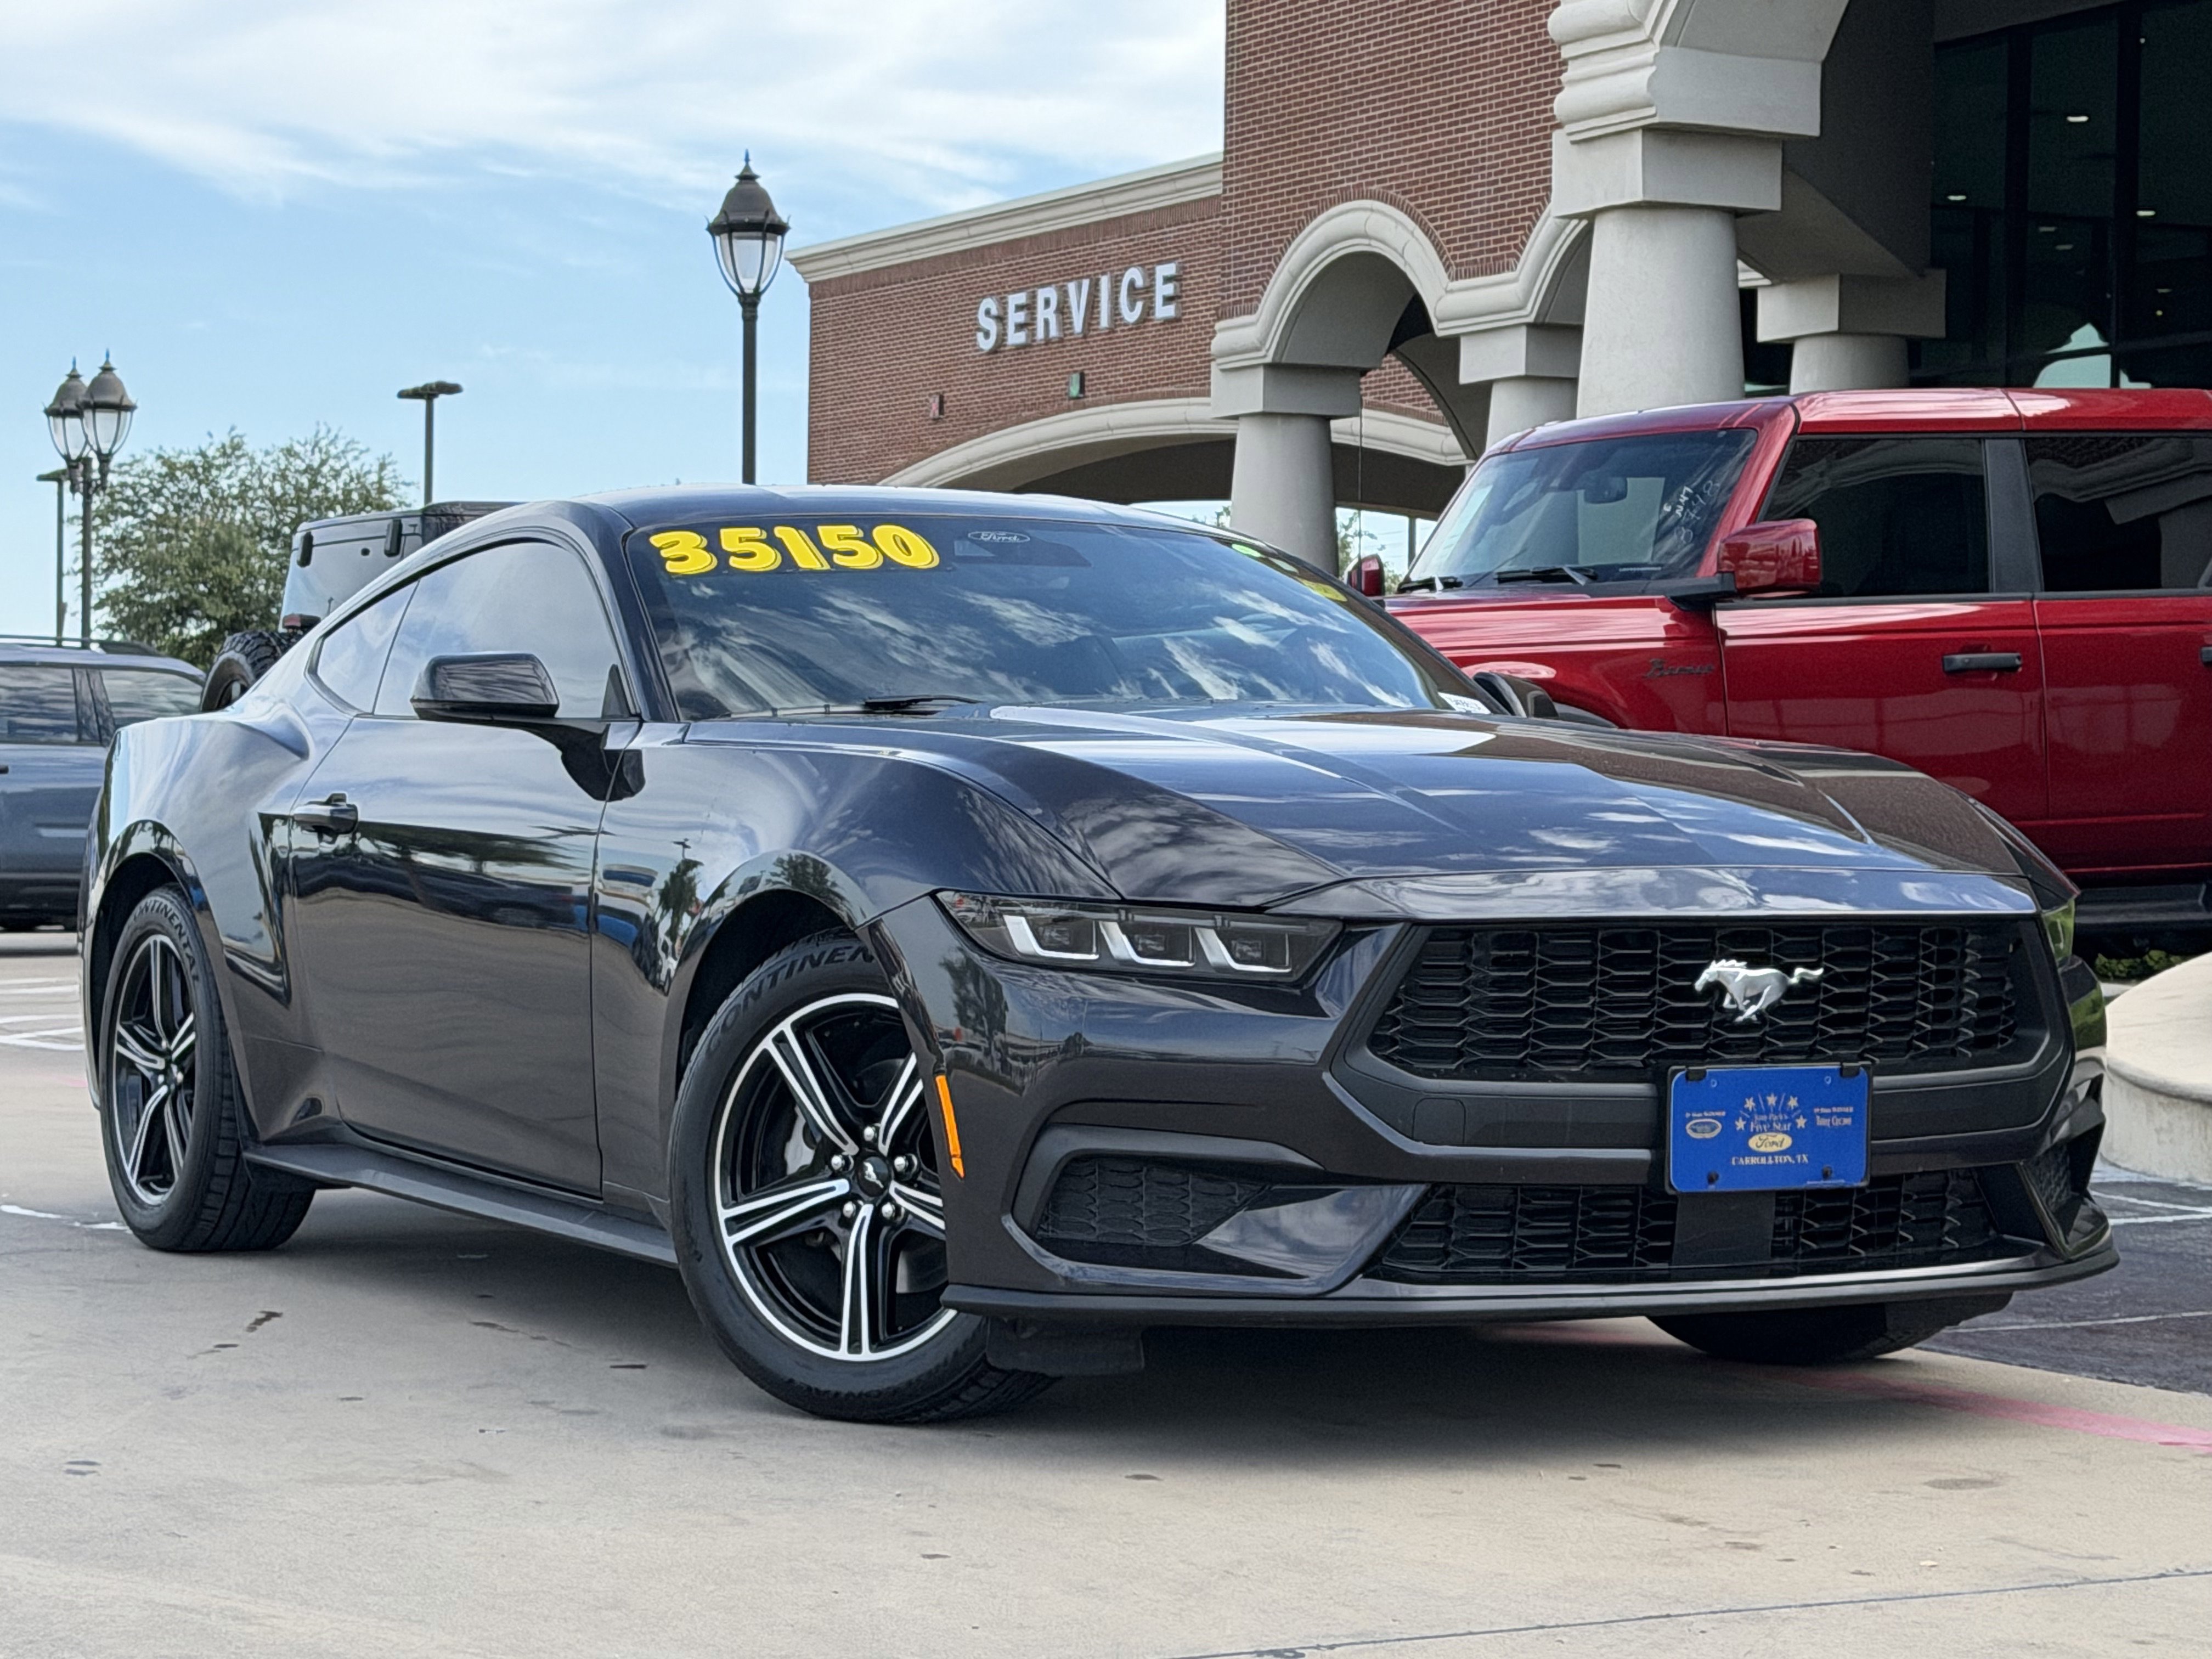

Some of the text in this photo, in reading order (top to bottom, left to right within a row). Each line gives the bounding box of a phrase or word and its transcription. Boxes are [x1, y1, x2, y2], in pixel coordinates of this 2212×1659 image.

[977, 262, 1180, 353] SERVICE
[980, 532, 1020, 542] Ford
[649, 524, 940, 574] 35150
[1756, 1136, 1785, 1148] Ford
[1796, 1153, 1809, 1164] TX
